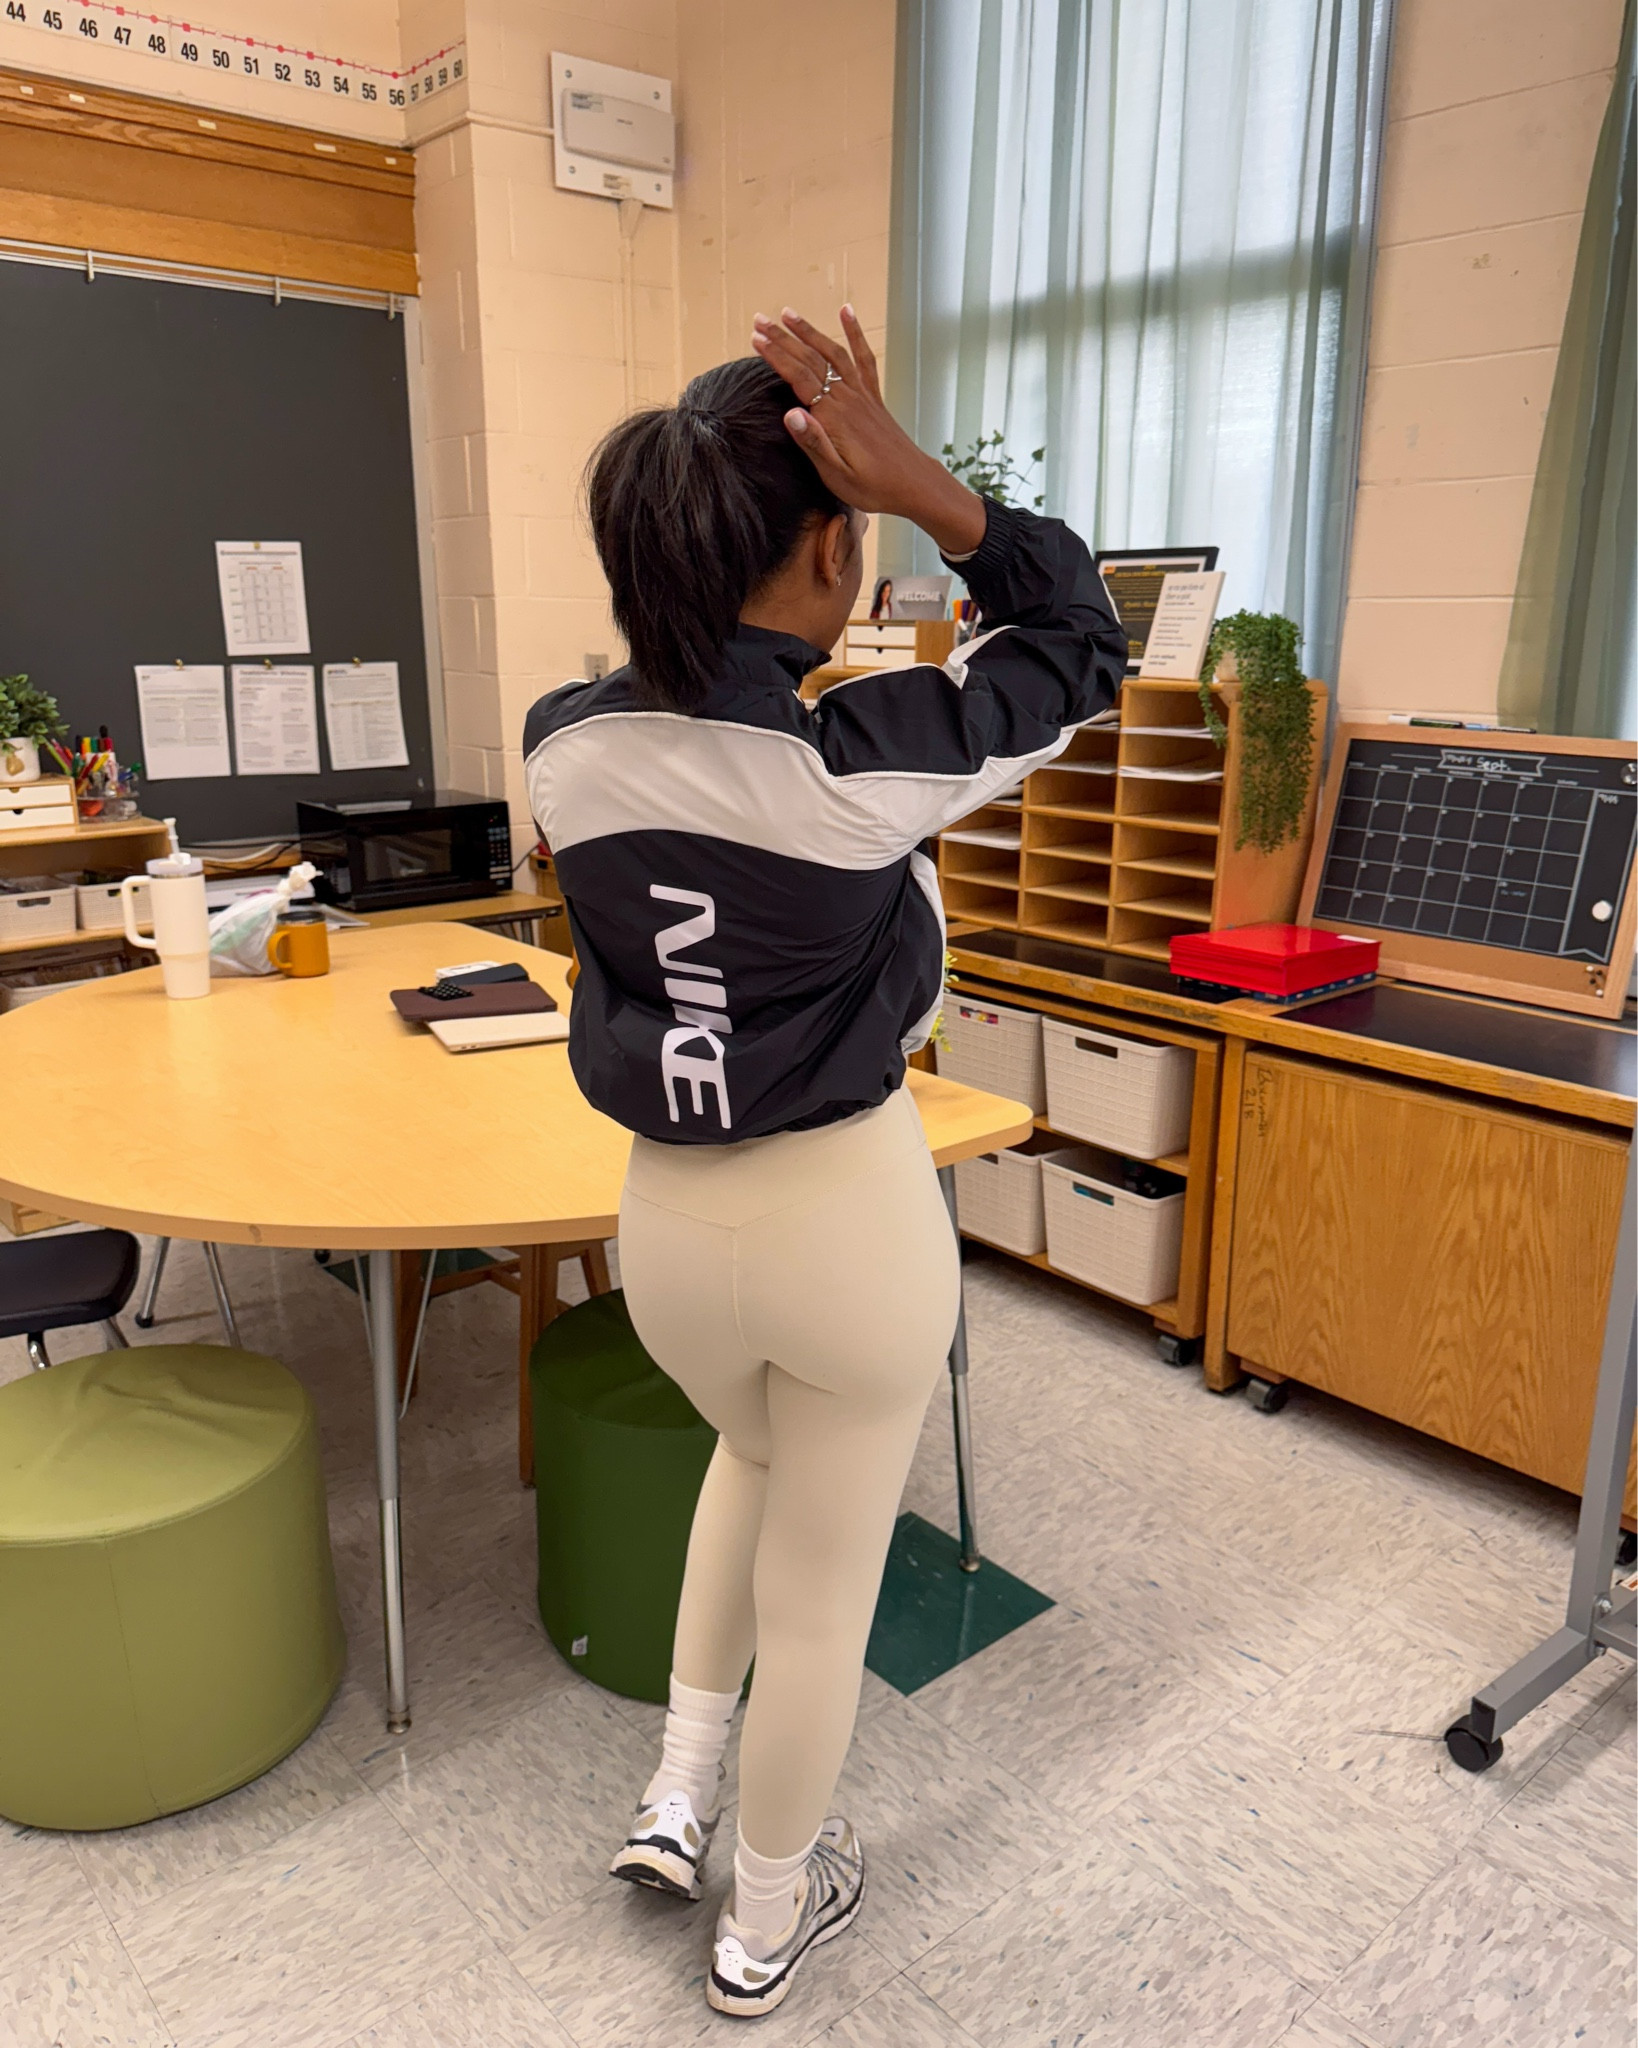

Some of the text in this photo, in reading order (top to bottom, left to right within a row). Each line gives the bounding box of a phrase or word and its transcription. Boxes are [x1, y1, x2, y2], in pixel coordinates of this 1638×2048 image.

[6, 1, 405, 106] 44 45 46 47 48 49 50 51 52 53 54 55 56
[411, 59, 463, 102] 57 58 59 60
[896, 590, 941, 602] WELCOME
[650, 884, 733, 1129] NIKE
